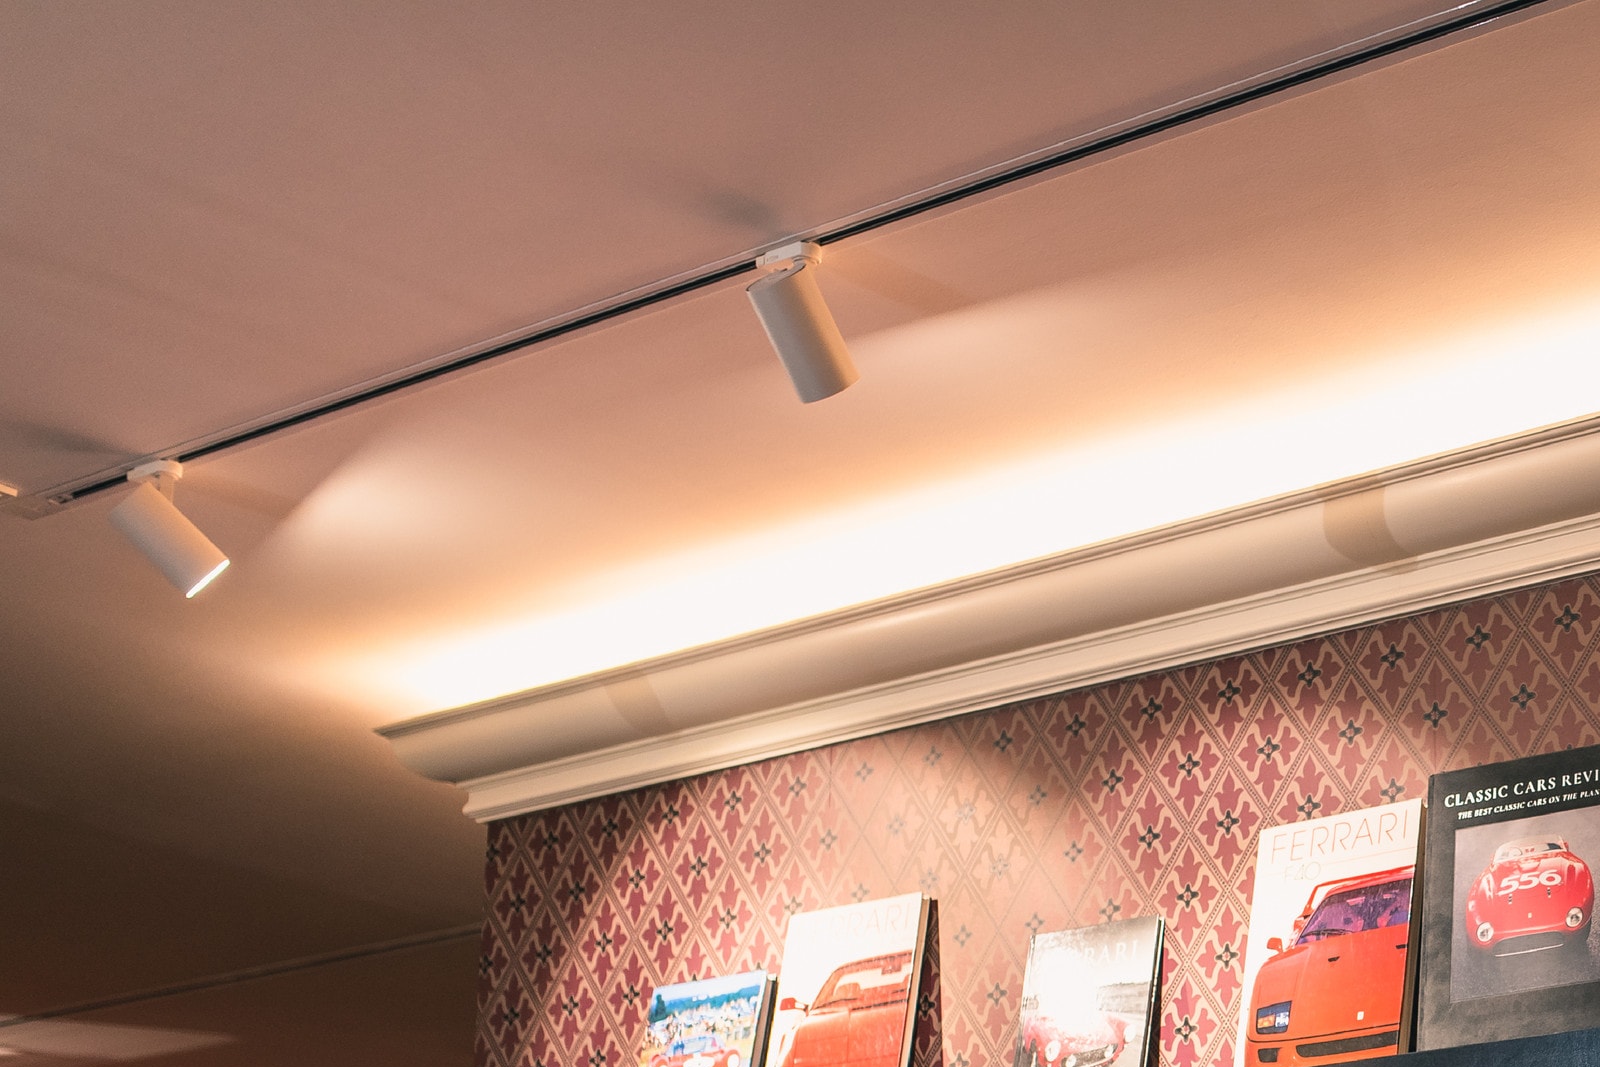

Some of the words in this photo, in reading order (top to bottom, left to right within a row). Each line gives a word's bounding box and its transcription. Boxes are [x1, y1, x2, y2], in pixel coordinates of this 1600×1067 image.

[1444, 785, 1509, 808] CLASSIC
[1513, 777, 1557, 796] CARS
[1457, 810, 1473, 820] THE
[1474, 807, 1493, 817] BEST
[1493, 801, 1526, 813] CLASSIC
[1527, 797, 1546, 808] CARS
[1548, 795, 1560, 804] ON
[1562, 793, 1577, 802] THE
[1270, 809, 1408, 864] FERRARI
[1284, 861, 1321, 883] F40
[1497, 869, 1563, 897] 556
